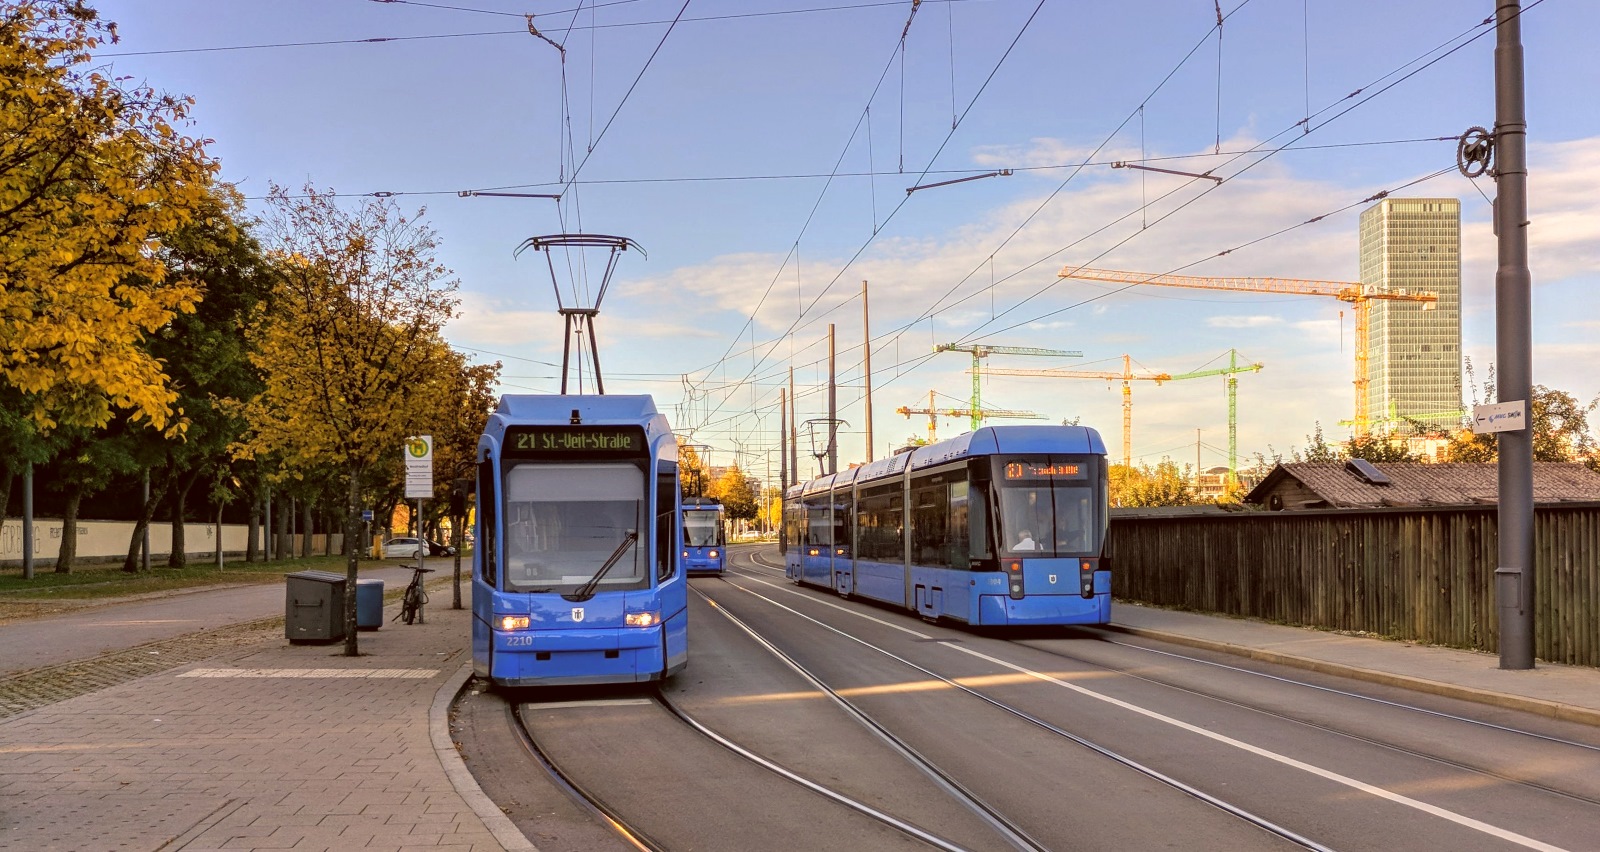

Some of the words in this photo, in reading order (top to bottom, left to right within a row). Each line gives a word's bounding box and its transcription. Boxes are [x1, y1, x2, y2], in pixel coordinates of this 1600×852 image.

[517, 433, 536, 449] 21
[542, 433, 631, 449] St.-Veit-Straße
[506, 636, 533, 647] 2210
